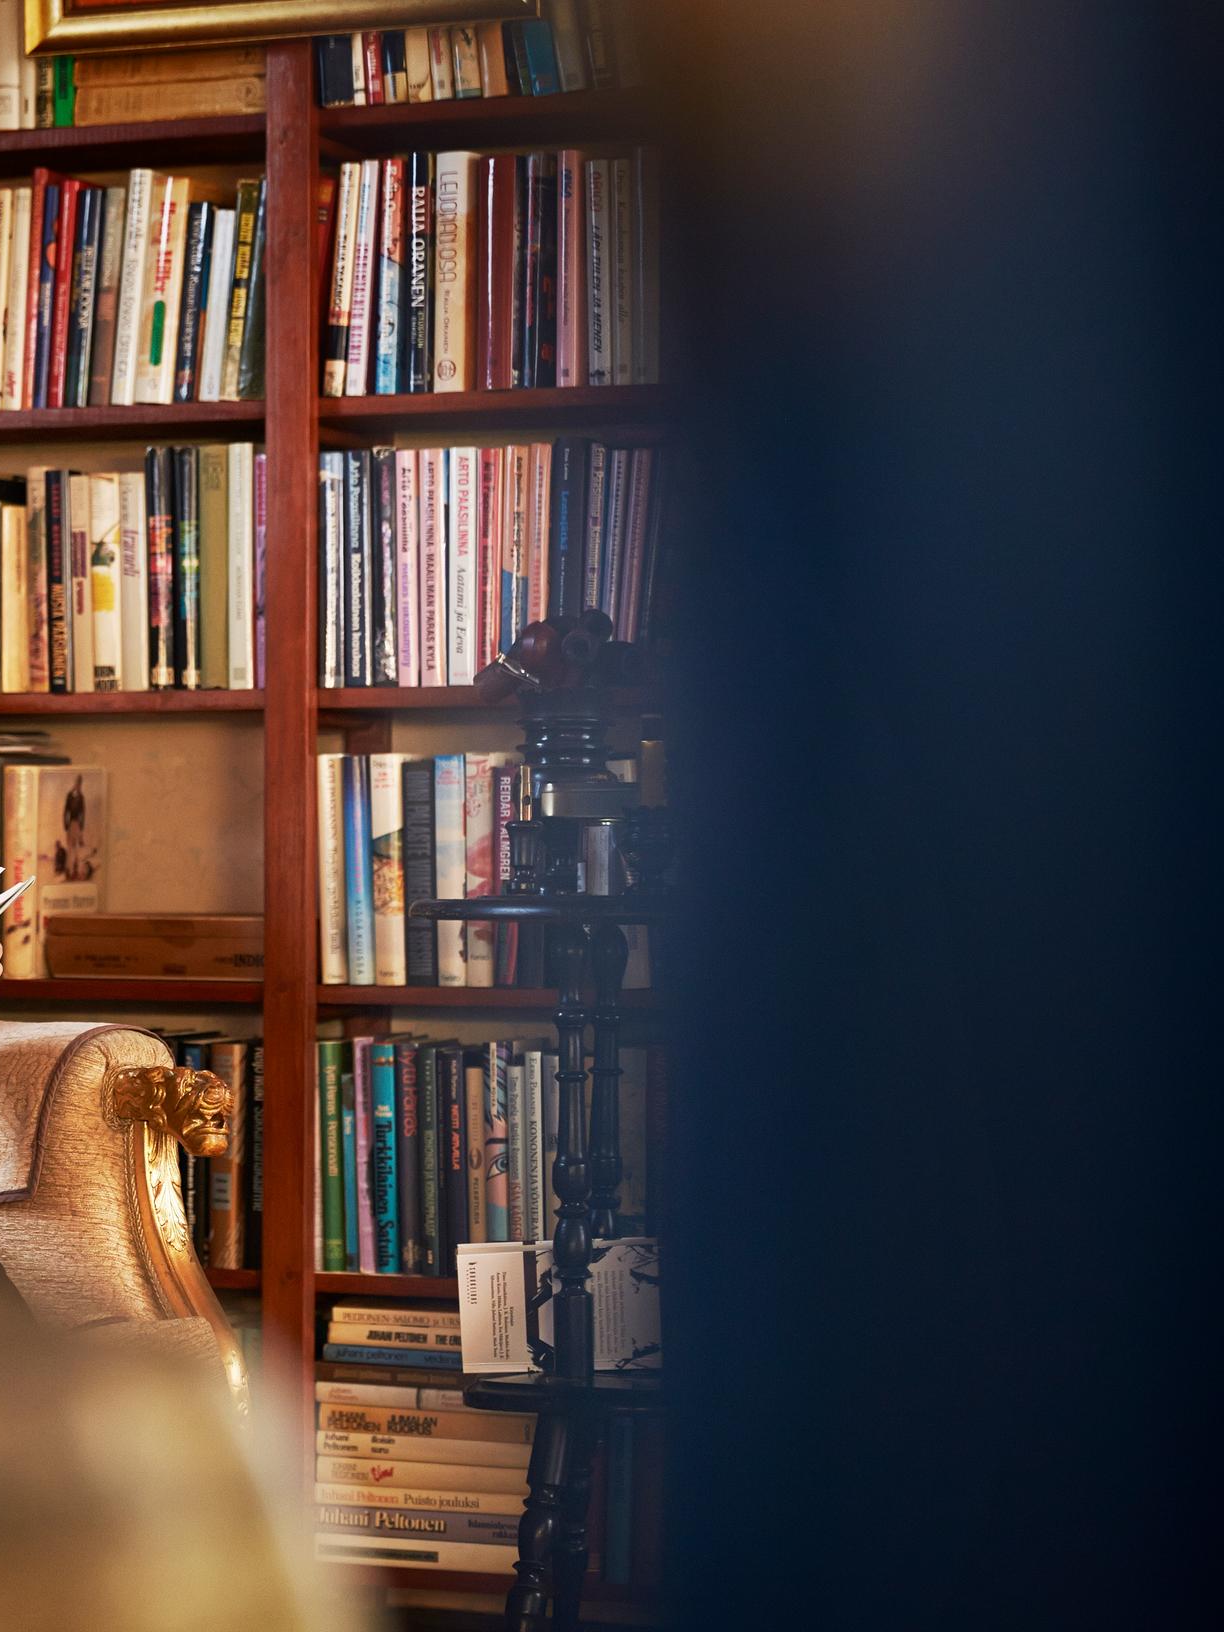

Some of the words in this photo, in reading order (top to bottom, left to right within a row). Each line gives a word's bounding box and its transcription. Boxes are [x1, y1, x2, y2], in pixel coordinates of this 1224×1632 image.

[411, 186, 426, 233] RAIJA
[438, 171, 458, 244] LEIJONAN
[411, 238, 426, 308] ORANEN
[438, 247, 457, 283] OSA
[592, 256, 601, 290] TULEN
[592, 295, 601, 308] JA
[593, 312, 602, 353] MENEN
[456, 457, 469, 487] ARTO
[457, 491, 470, 558] PAASILINNA
[426, 554, 435, 607] MAAILMAN
[456, 566, 467, 610] Aatami
[426, 610, 435, 643] PARAS
[454, 612, 467, 625] ja
[455, 627, 467, 655] Eeva
[500, 776, 511, 817] REIDAR
[407, 804, 431, 856] PALASTE
[499, 820, 511, 881] PALMGREN
[355, 934, 365, 975] KUUSSA
[375, 1120, 393, 1215] Turkkilainen
[529, 1120, 538, 1174] KONONEN
[511, 1182, 522, 1201] ISÄN
[529, 1175, 538, 1185] JA
[530, 1186, 541, 1241] YÖVIERAAT
[377, 1219, 394, 1267] Satula
[442, 1317, 461, 1327] URS
[320, 1508, 369, 1527] Juhani
[374, 1511, 448, 1534] Peltonen
[404, 1493, 438, 1507] Puisto
[439, 1496, 480, 1510] jouluksi
